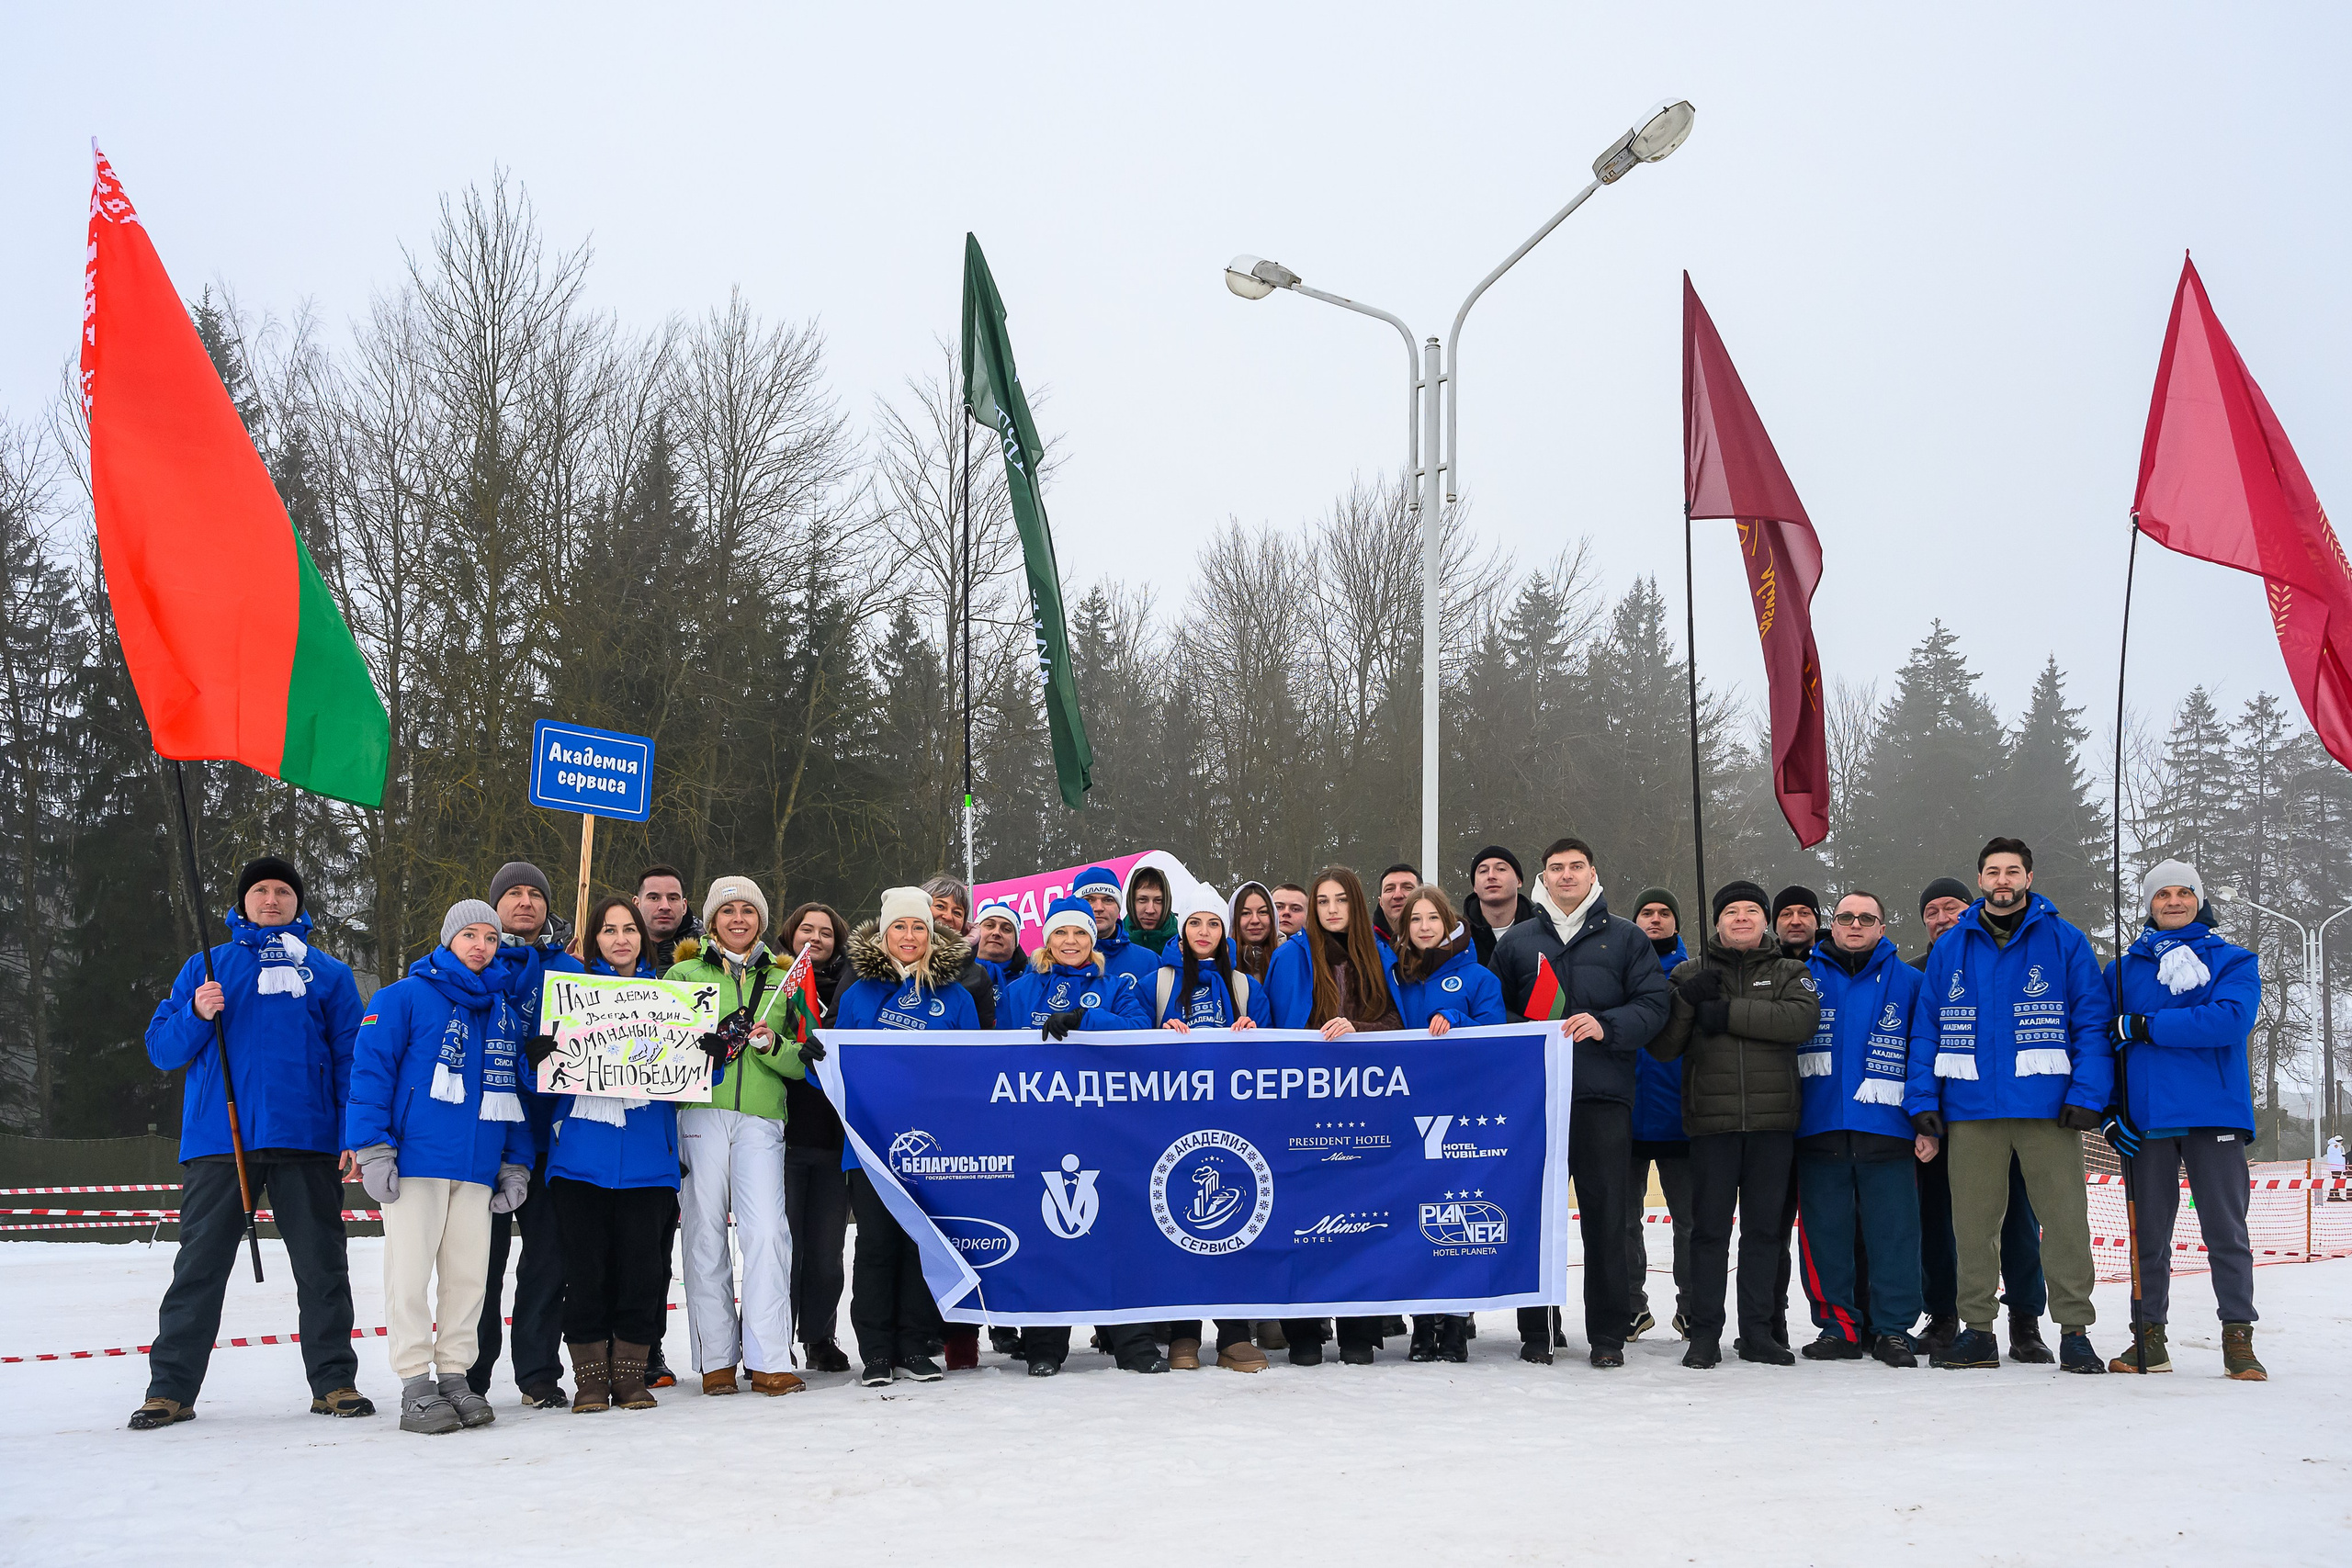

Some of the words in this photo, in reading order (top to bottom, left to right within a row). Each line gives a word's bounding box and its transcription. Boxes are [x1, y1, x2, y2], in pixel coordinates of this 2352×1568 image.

[548, 741, 639, 775] Академия
[557, 770, 627, 795] сервиса
[614, 990, 659, 1004] ДЕВИЗ
[585, 1010, 639, 1025] ВСЕГДА
[2018, 1017, 2060, 1026] АКАДЕМИЯ
[663, 1029, 703, 1050] ДУХ
[989, 1069, 1215, 1108] АКАДЕМИЯ
[1229, 1066, 1410, 1100] СЕРВИСА
[1173, 1132, 1250, 1156] АКАДЕМИЯ
[1288, 1136, 1351, 1146] PRESIDENT
[1355, 1134, 1392, 1145] HOTEL
[1443, 1148, 1509, 1159] YUBILEINY
[902, 1155, 1015, 1174] БЕЛАРУСЬТОРГ
[1294, 1213, 1388, 1235] Minsk
[947, 1236, 1007, 1251] аркет
[1180, 1236, 1246, 1253] СЕРВИСА
[1433, 1248, 1460, 1257] HOTEL
[1461, 1247, 1497, 1256] PLANETA
